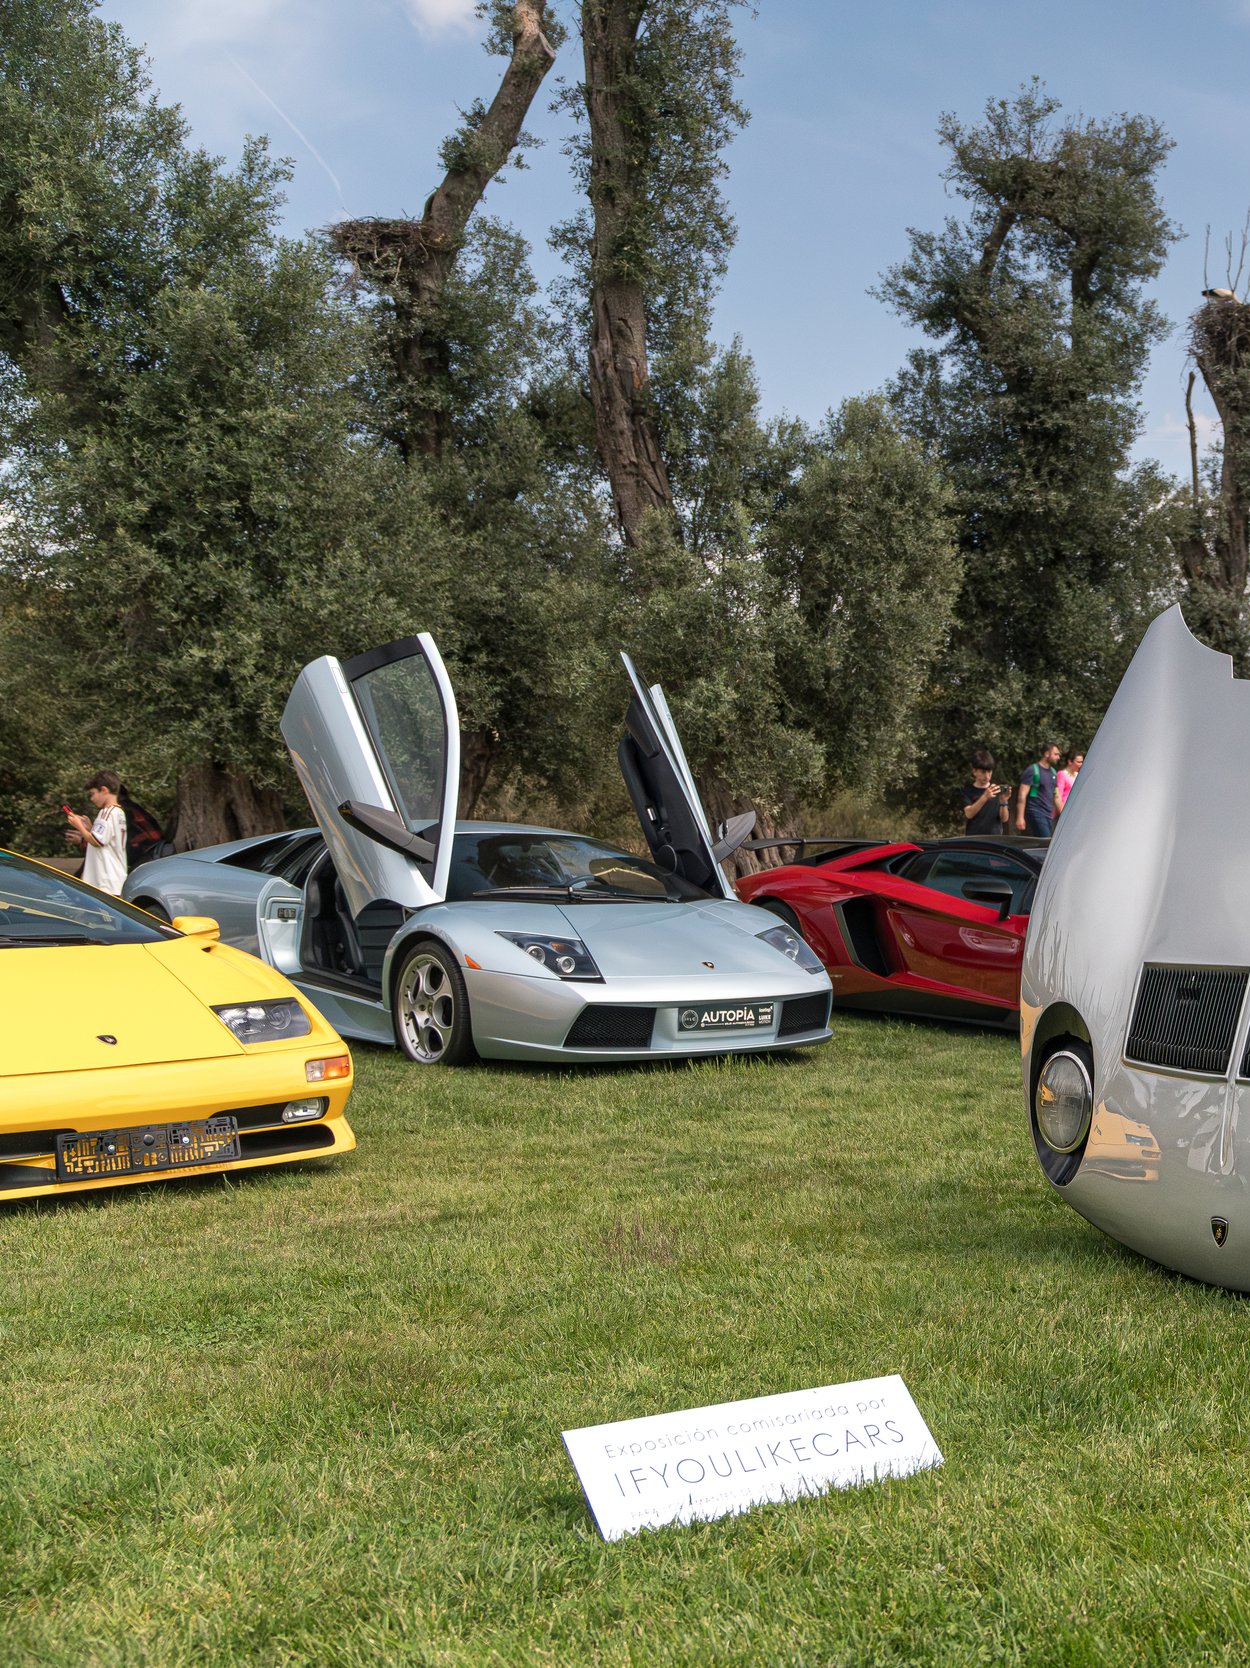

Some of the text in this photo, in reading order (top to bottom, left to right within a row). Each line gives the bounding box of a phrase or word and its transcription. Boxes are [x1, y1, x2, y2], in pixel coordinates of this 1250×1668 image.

[604, 1397, 886, 1459] Exposición comisariada por
[614, 1419, 904, 1498] IFYOULIKECARS
